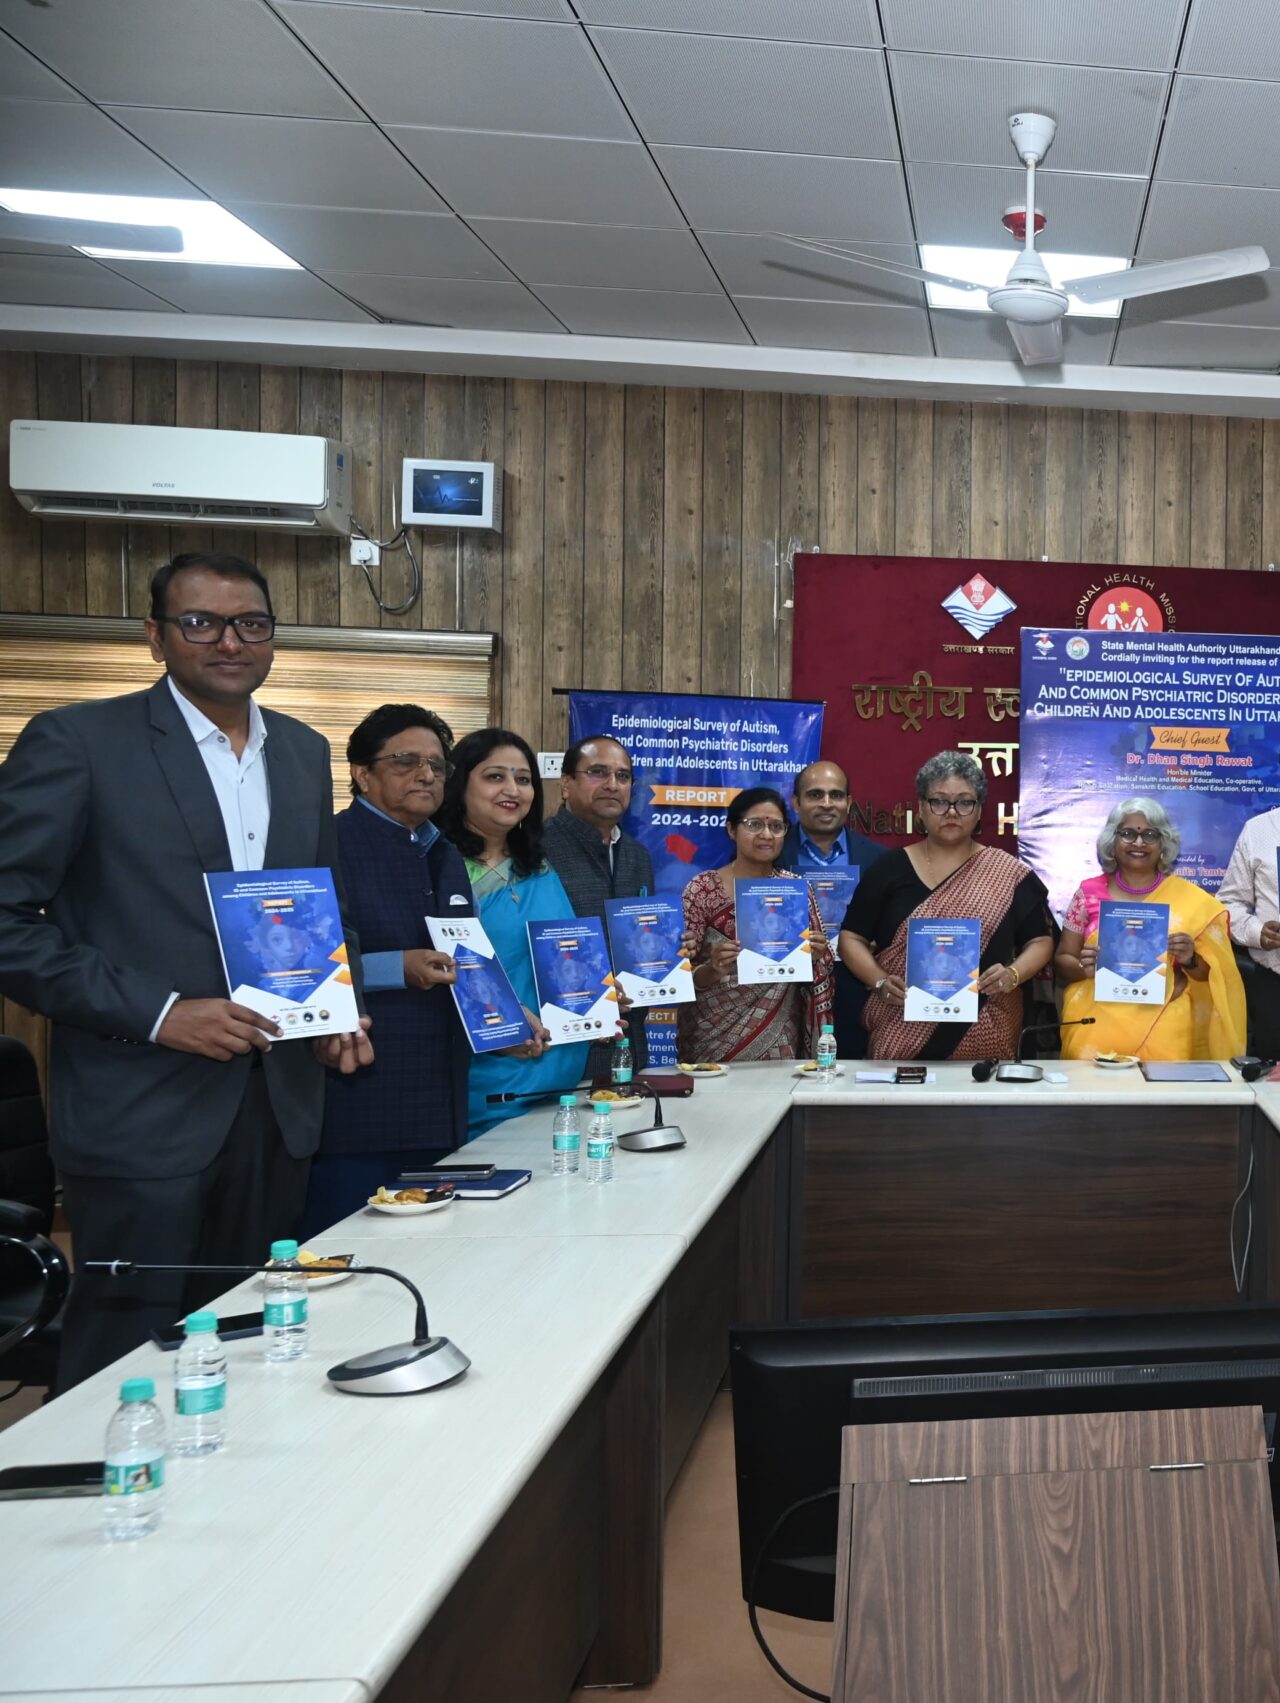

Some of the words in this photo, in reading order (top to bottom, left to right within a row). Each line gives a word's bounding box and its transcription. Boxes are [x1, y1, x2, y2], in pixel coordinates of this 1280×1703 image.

[1075, 584, 1101, 630] TIONAL
[1104, 572, 1156, 591] HEALTH
[1159, 592, 1177, 633] MISSI
[986, 646, 1015, 655] सरकार
[1101, 640, 1125, 651] State
[1126, 640, 1155, 652] Mental
[1157, 641, 1185, 653] Health
[1187, 643, 1227, 655] Authority
[1101, 652, 1139, 665] Cordially
[1141, 653, 1174, 666] inviting
[1176, 654, 1190, 664] for
[1191, 655, 1205, 665] the
[1207, 656, 1233, 667] report
[1235, 656, 1267, 666] release
[1268, 657, 1278, 666] of
[852, 670, 973, 732] राष्ट्रीय
[612, 714, 692, 733] Epidemiological
[693, 718, 728, 735] Survey
[730, 720, 741, 732] of
[742, 720, 780, 735] Autism,
[635, 735, 680, 749] Common
[682, 737, 739, 752] Psychiatric
[740, 739, 789, 754] Disorders
[1159, 730, 1188, 746] Chief
[1190, 730, 1222, 745] Guest
[655, 755, 674, 768] and
[676, 756, 737, 771] Adolescents
[739, 758, 750, 771] in
[751, 759, 814, 774] Uttarakhan
[1126, 753, 1144, 765] Dr.
[1147, 753, 1177, 766] Dhan
[1180, 754, 1213, 768] Singh
[1216, 755, 1253, 767] Rawat
[1190, 769, 1213, 777] Minister
[1171, 776, 1193, 784] Medical
[1193, 777, 1225, 785] Education,
[1225, 778, 1264, 786] Co-operative,
[665, 789, 727, 803] REPORT
[1210, 785, 1241, 793] Education,
[651, 813, 727, 828] 2024-202
